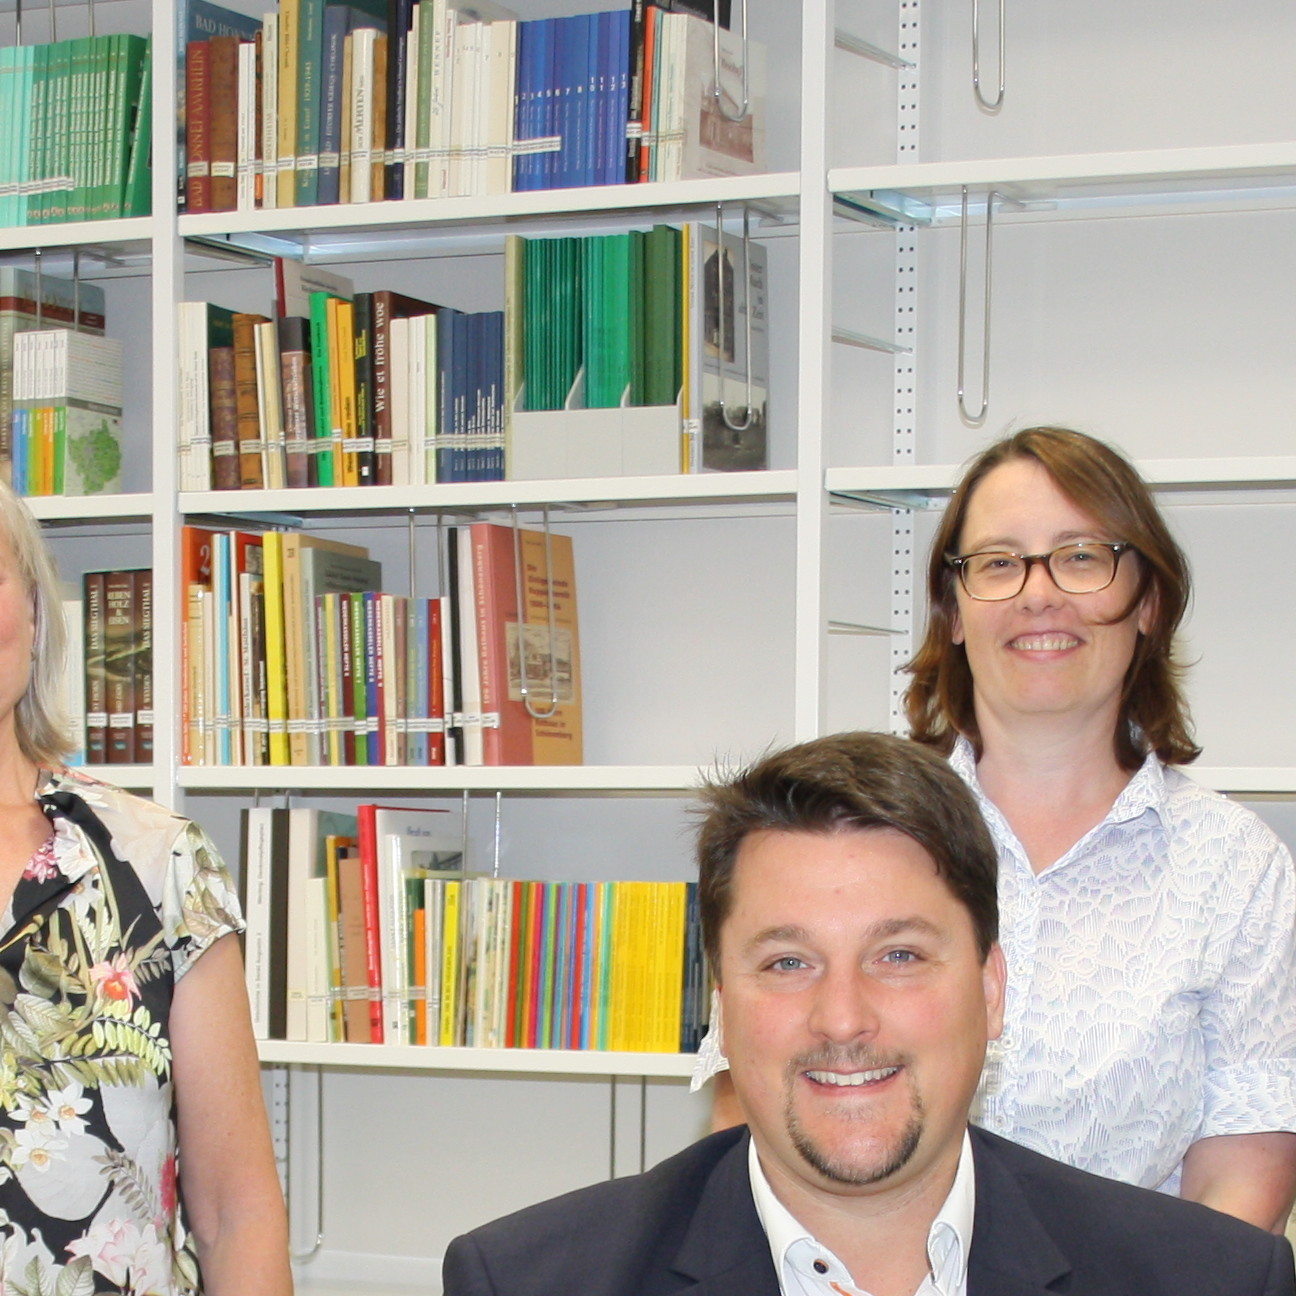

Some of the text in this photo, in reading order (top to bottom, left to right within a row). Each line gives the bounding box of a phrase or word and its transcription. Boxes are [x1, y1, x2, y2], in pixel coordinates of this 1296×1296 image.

[354, 88, 365, 135] MERTEN
[374, 333, 385, 366] fröhe
[375, 370, 385, 383] et
[375, 388, 385, 412] Wie
[90, 589, 99, 649] DAS SIEGTHAL
[142, 588, 152, 648] DAS SIEGTHAL
